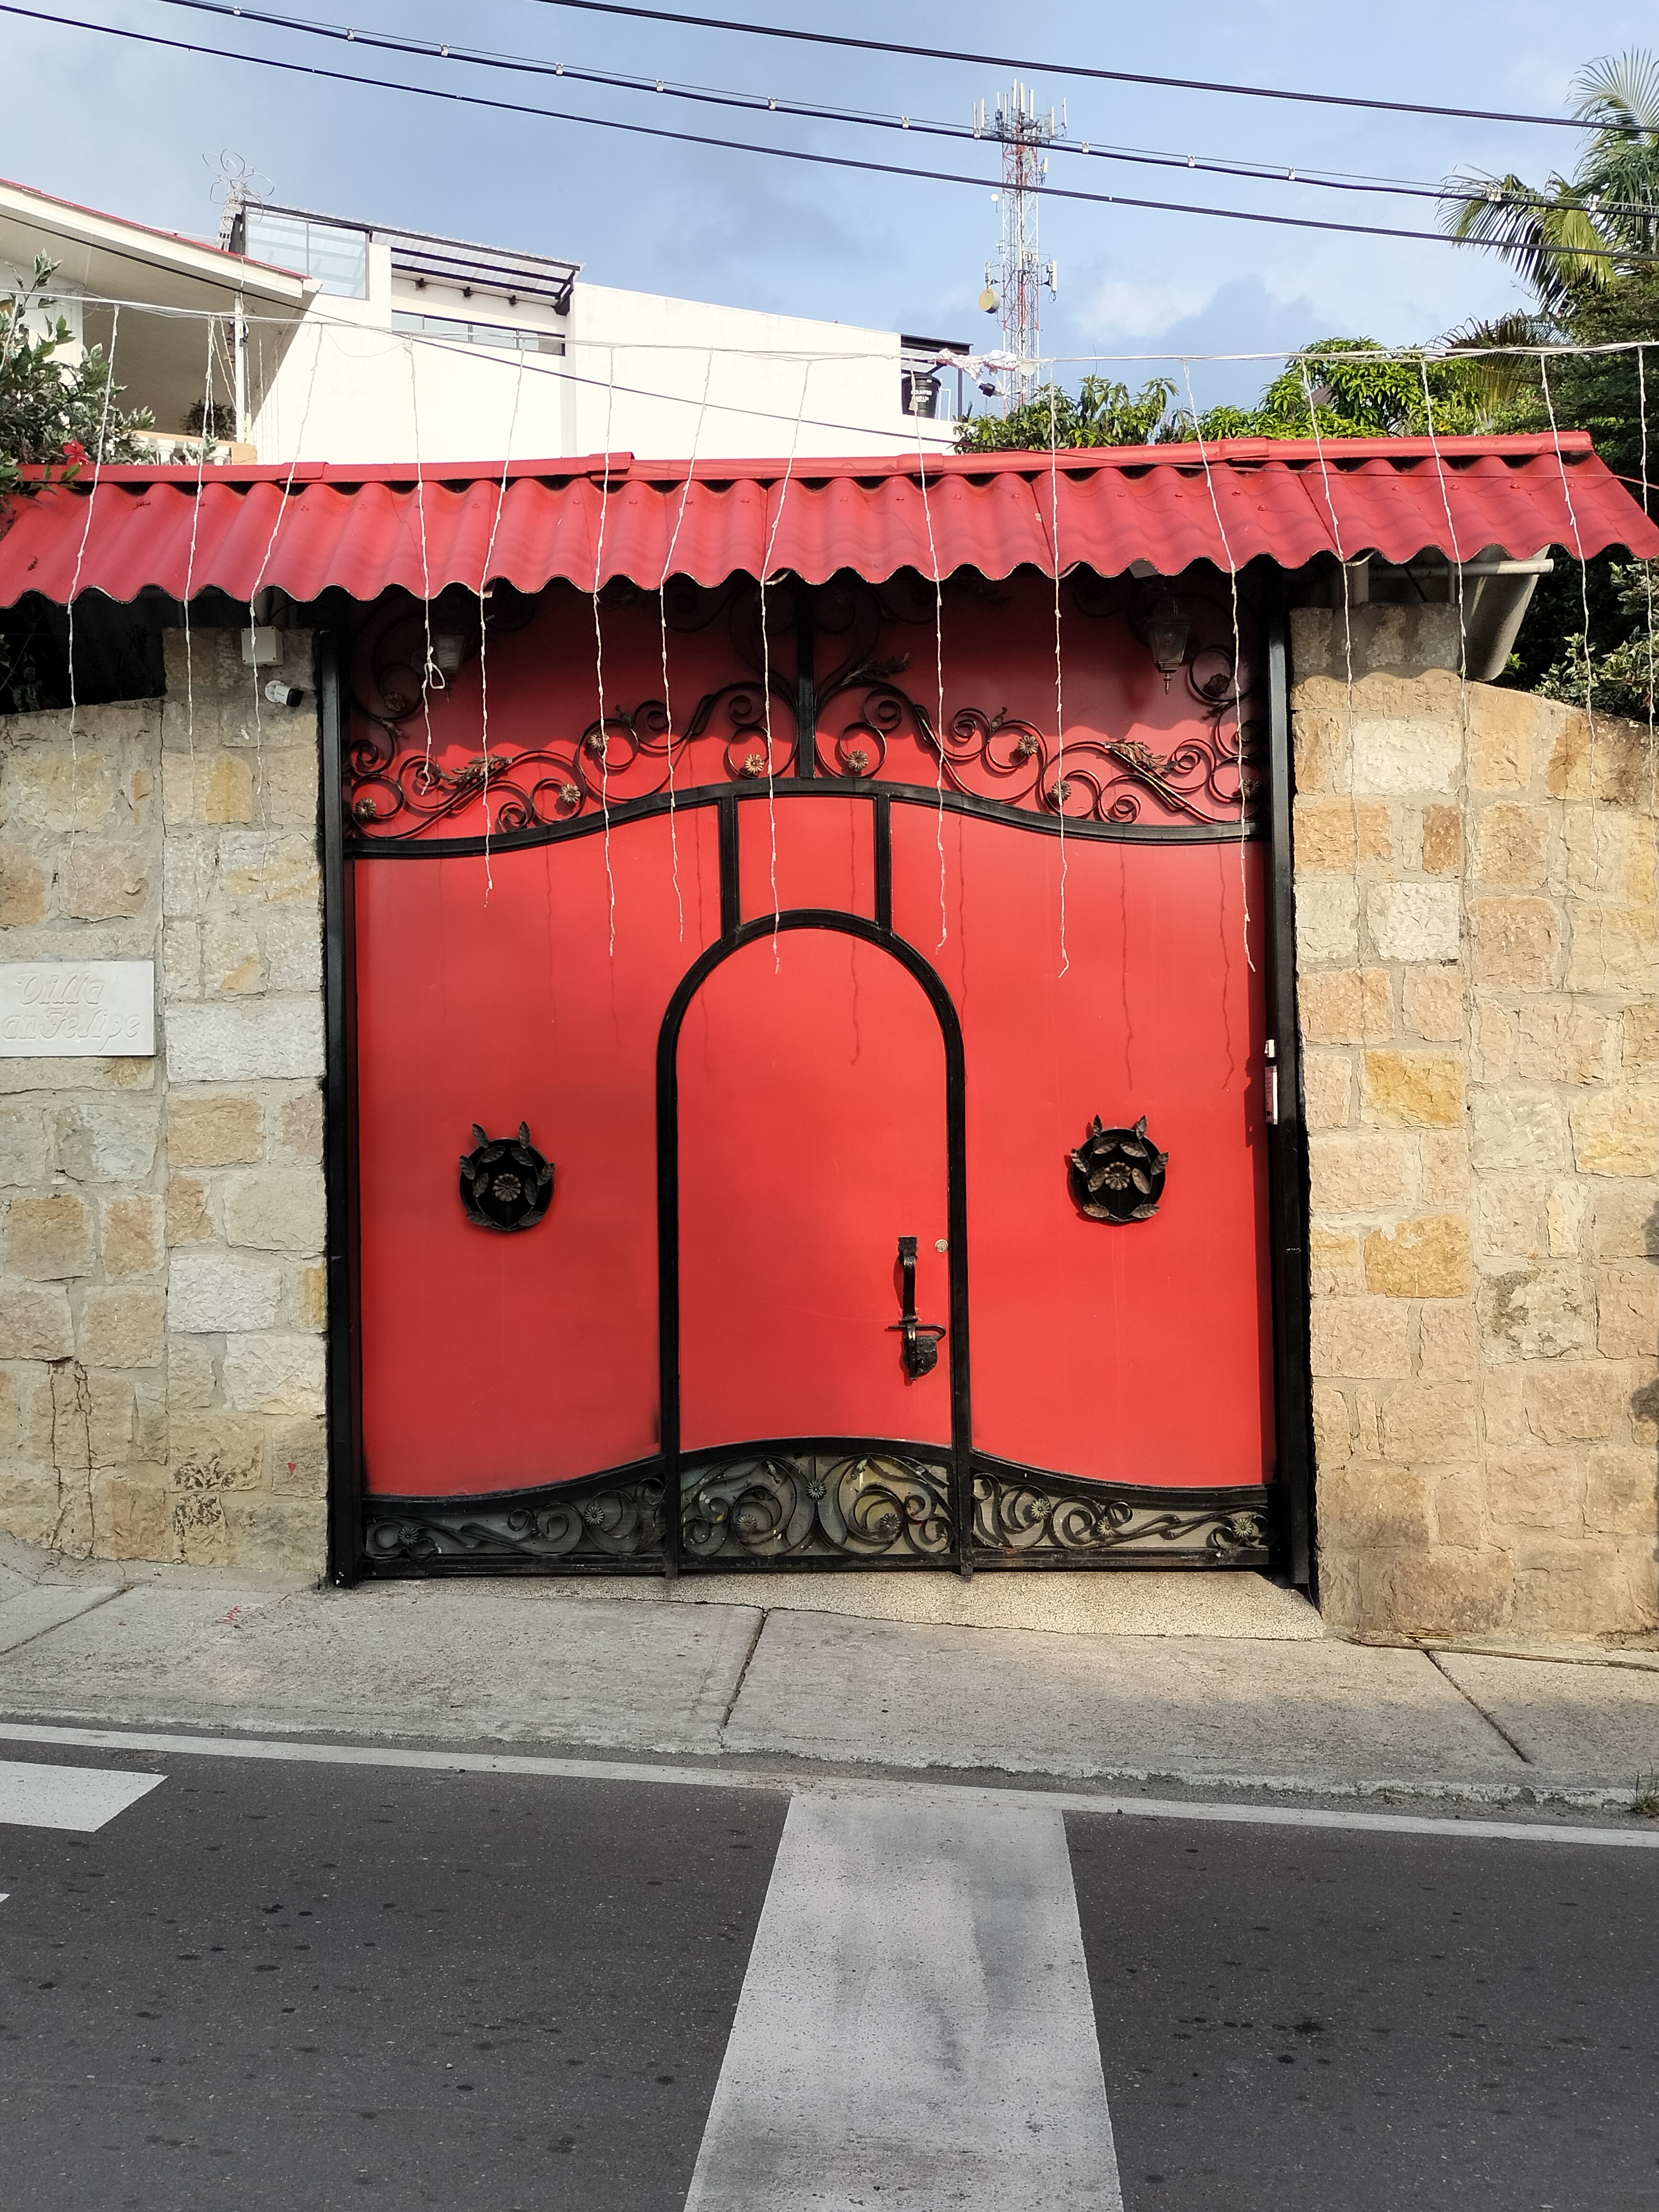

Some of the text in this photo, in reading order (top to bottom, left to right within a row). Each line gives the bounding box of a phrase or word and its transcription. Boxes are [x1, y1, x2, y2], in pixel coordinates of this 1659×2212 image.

[16, 971, 105, 1005] Villa
[2, 1007, 141, 1052] an Felipe
